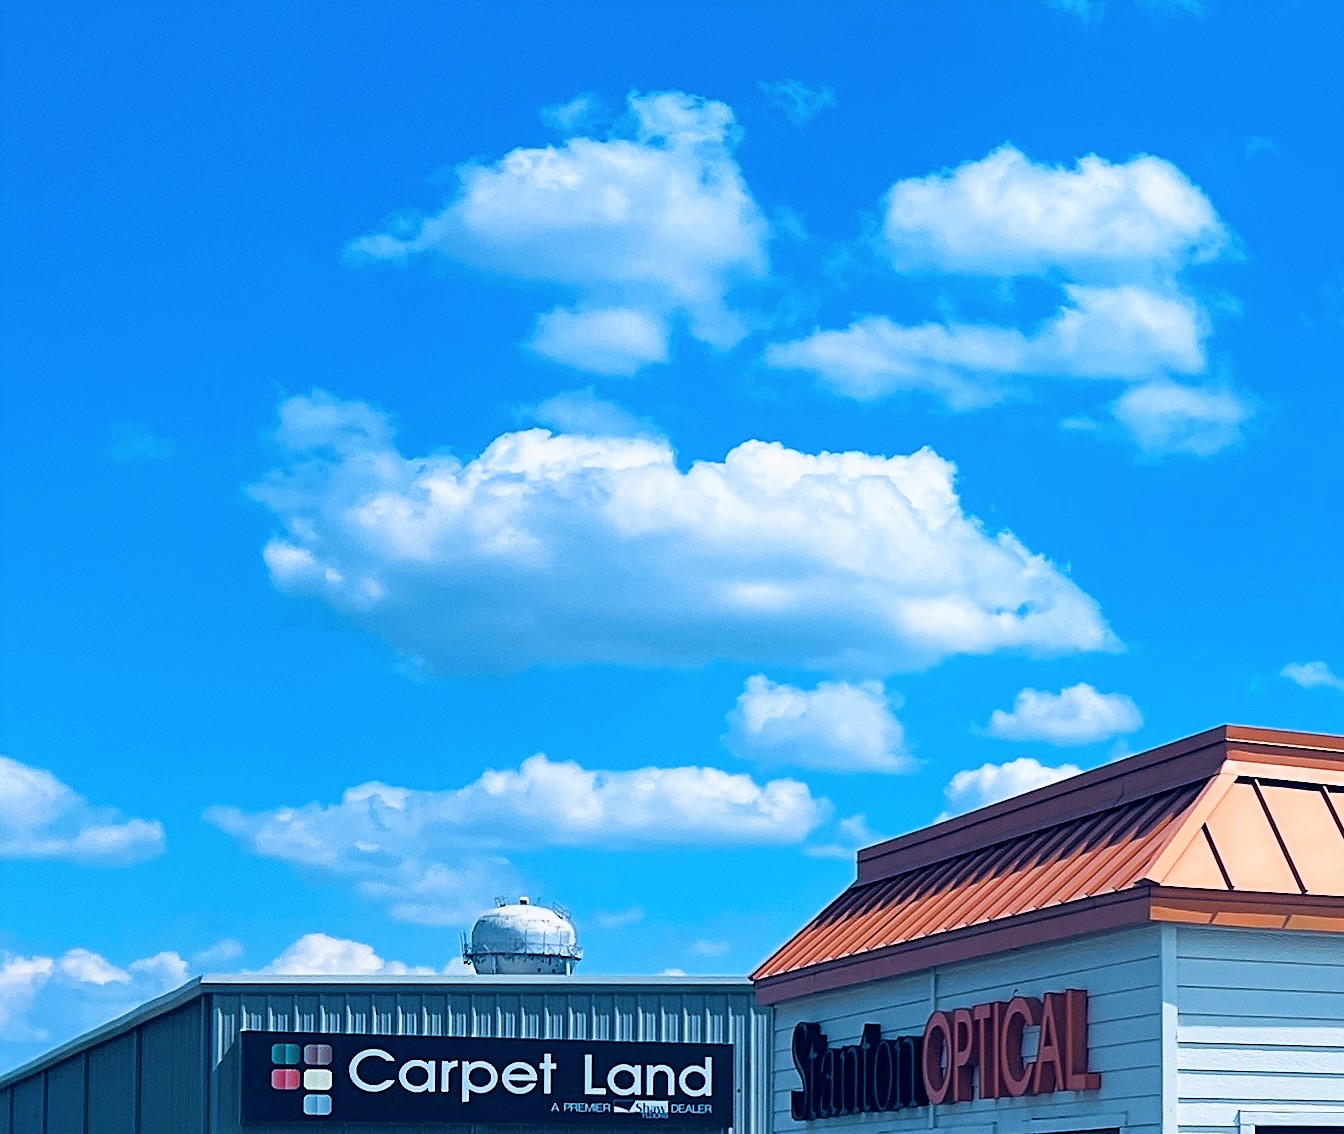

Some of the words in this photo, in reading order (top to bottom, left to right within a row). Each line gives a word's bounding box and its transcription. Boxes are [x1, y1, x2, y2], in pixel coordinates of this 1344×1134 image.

[349, 1048, 557, 1103] Carpet
[584, 1053, 713, 1097] Land
[791, 1021, 932, 1121] Stanton
[922, 989, 1101, 1106] OPTICAL
[551, 1102, 560, 1112] A
[563, 1102, 611, 1114] PREMIER
[670, 1104, 713, 1115] DEALER
